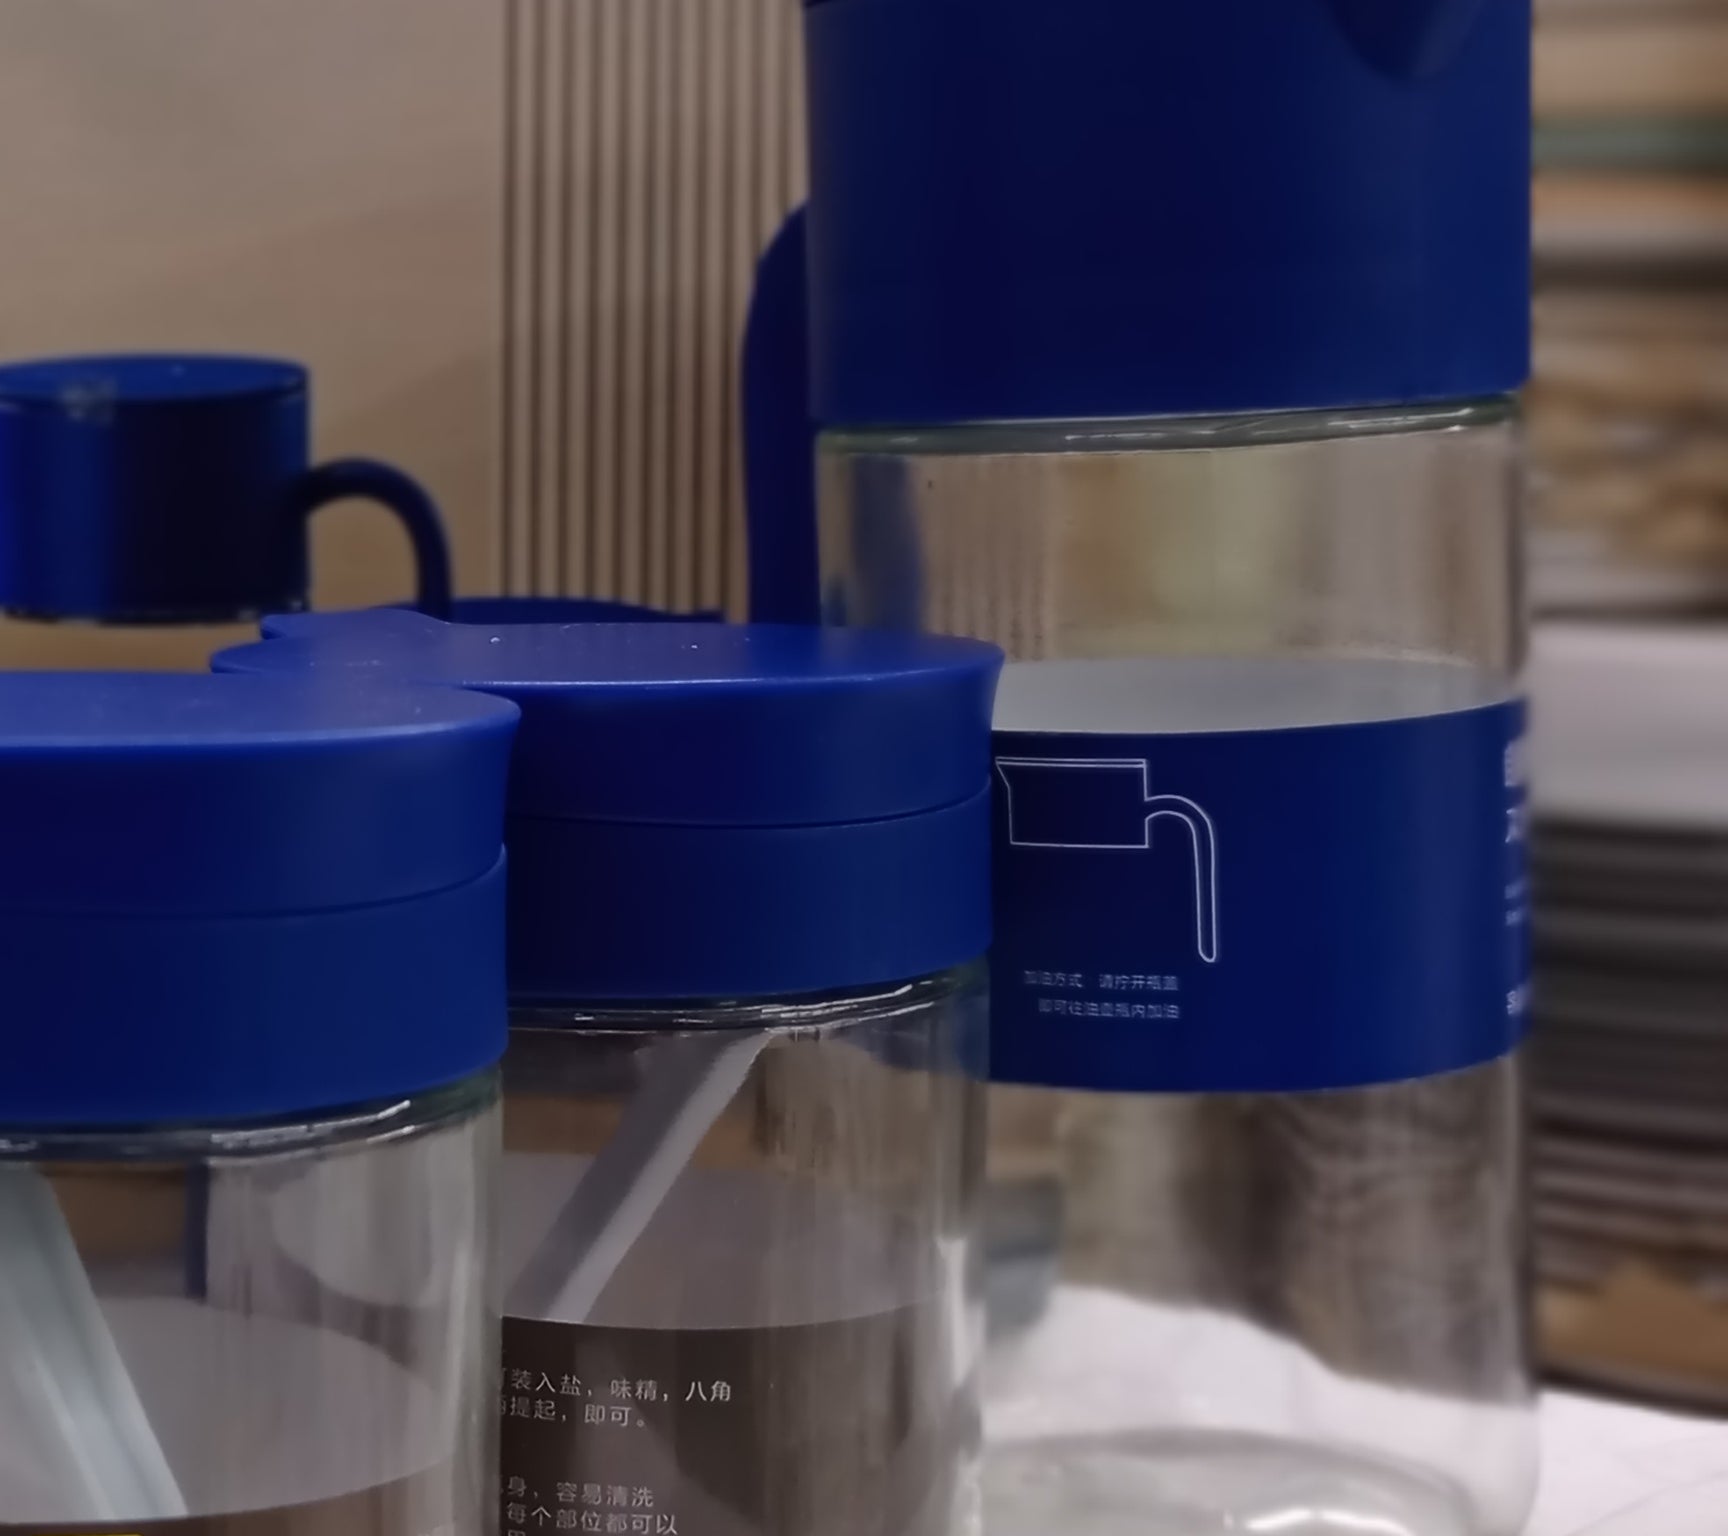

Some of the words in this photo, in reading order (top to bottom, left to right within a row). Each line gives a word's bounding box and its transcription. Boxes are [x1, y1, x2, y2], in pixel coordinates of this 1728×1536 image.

[500, 1474, 654, 1509] 身，容易清洗
[507, 1501, 678, 1536] 每个部位都可以
